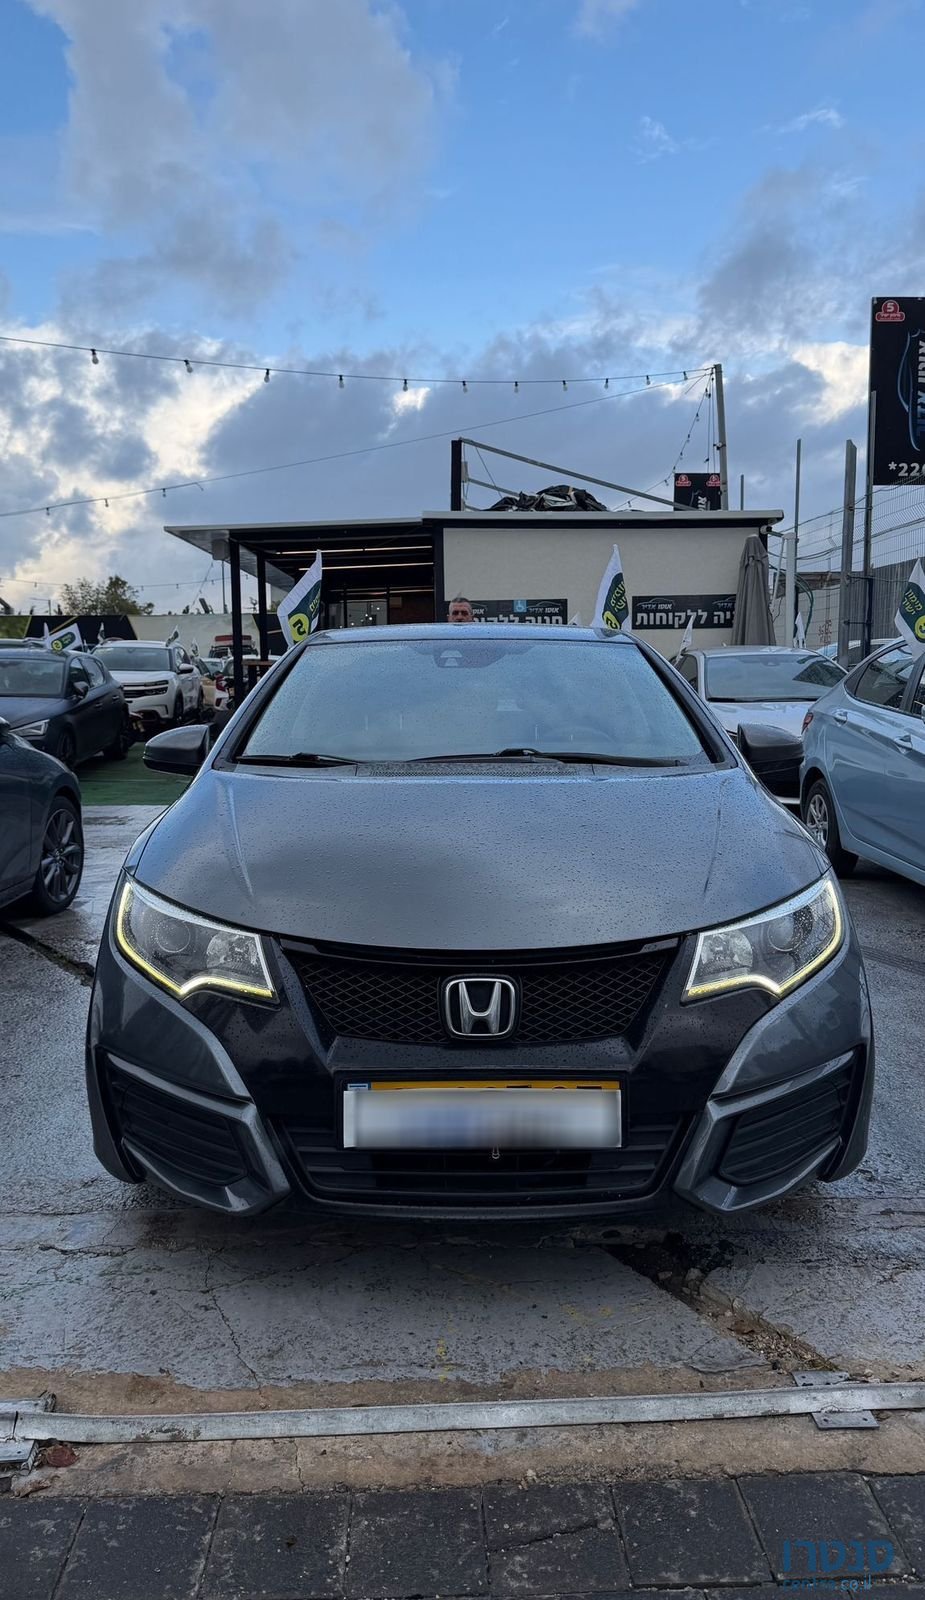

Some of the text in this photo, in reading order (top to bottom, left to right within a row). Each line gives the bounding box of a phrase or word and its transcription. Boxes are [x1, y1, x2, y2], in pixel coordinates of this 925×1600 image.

[902, 597, 916, 615] ישיר
[904, 588, 923, 610] מימון
[635, 609, 735, 628] יה ללקוחות
